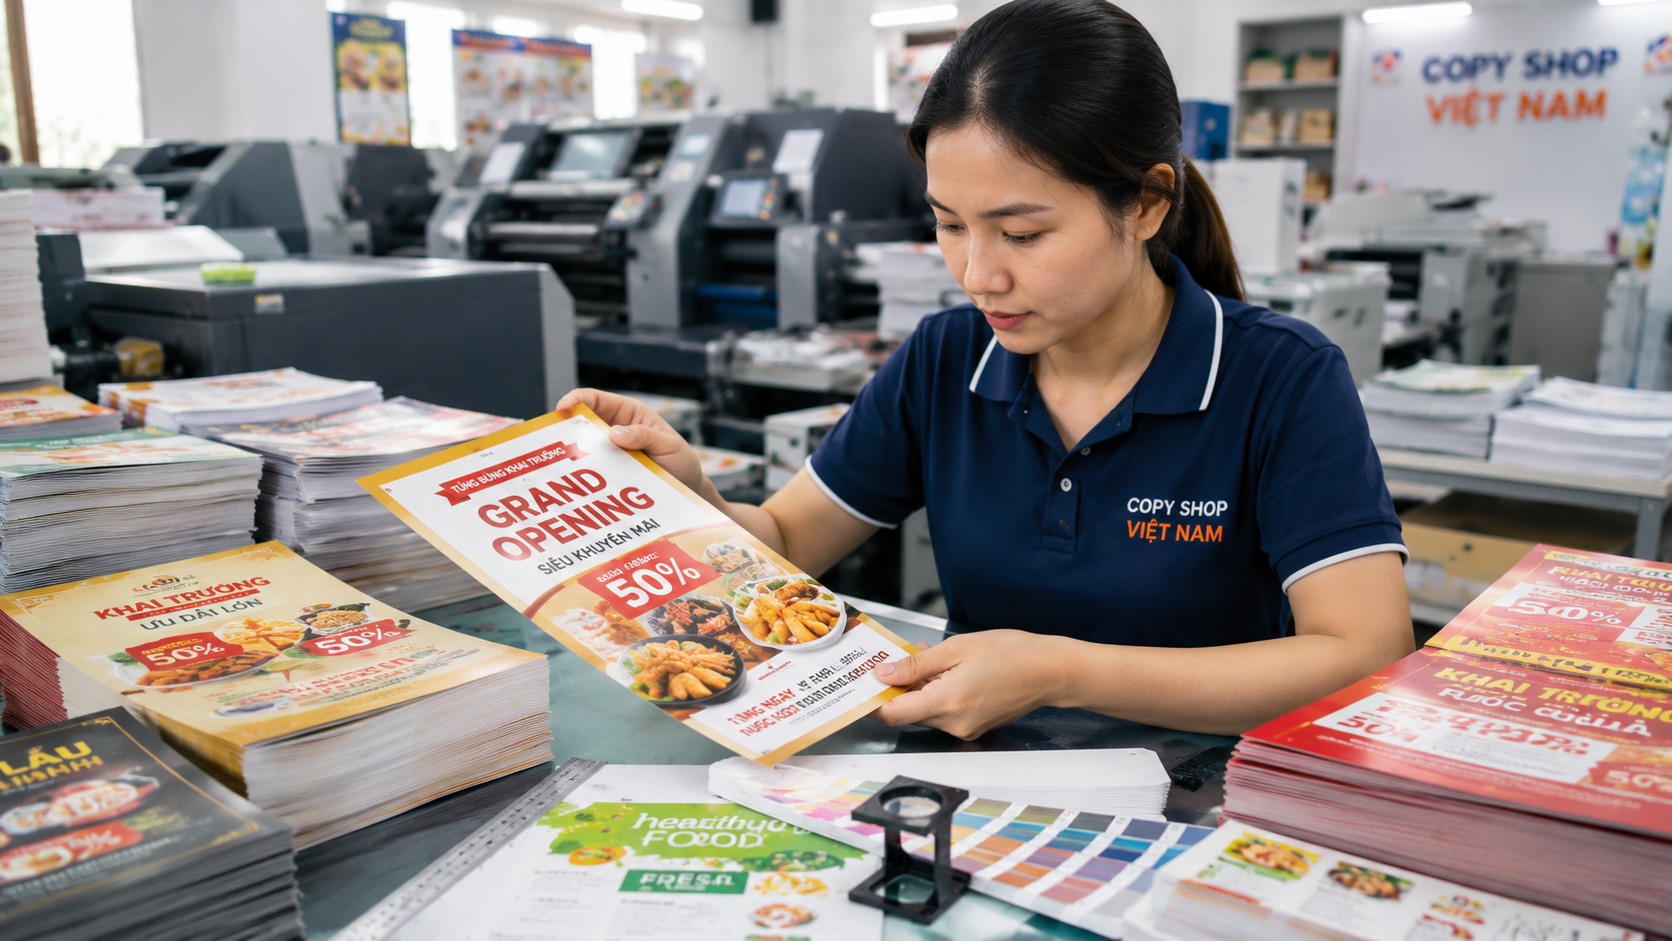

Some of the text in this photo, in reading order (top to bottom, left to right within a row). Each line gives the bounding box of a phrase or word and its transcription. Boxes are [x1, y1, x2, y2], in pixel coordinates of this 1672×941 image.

[1421, 46, 1619, 83] COPY SHOP
[1515, 87, 1608, 122] NAM
[477, 468, 608, 529] GRAND
[1126, 497, 1228, 517] COPY SHOP
[491, 486, 656, 562] OPENING
[1126, 518, 1223, 543] VIỆT NAM
[605, 557, 701, 608] 50%
[94, 598, 166, 620] KHAI
[147, 643, 226, 666] 50%
